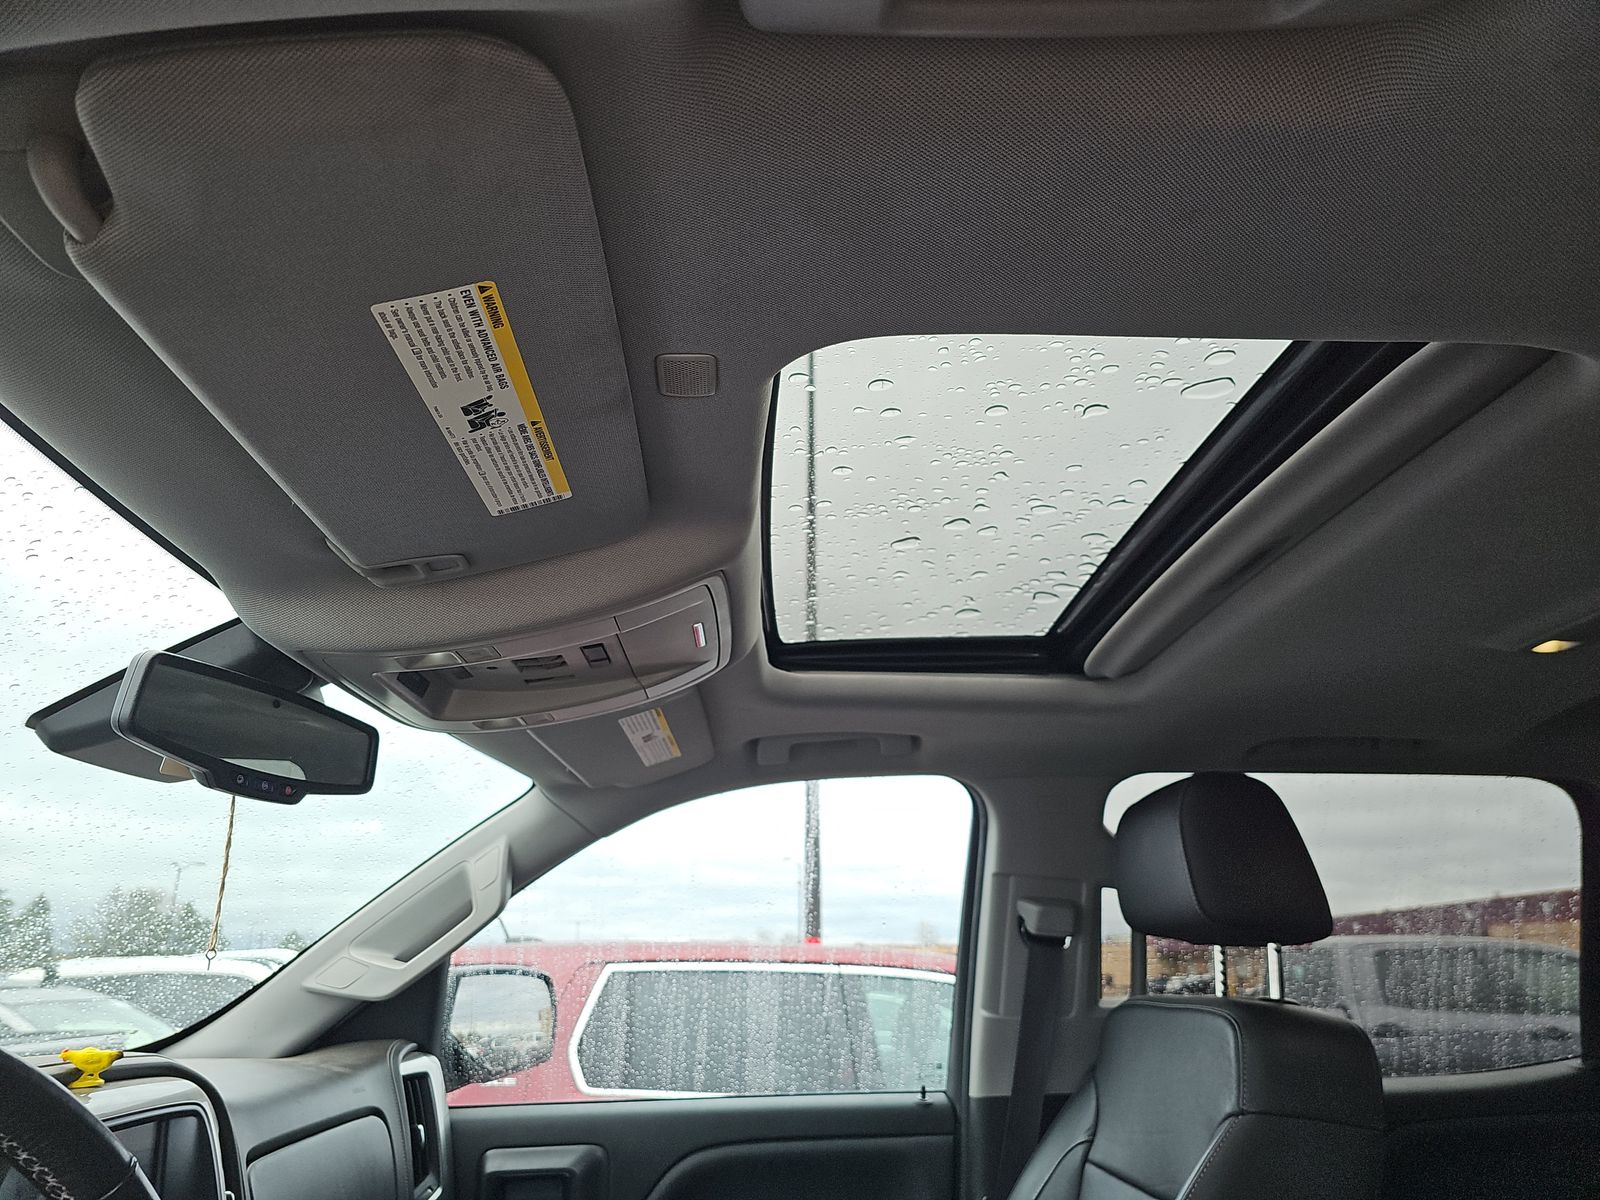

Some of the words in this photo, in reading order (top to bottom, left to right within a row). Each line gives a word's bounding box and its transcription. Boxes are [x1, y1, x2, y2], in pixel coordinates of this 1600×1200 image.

[433, 300, 444, 309] The
[459, 289, 476, 308] EVEN
[418, 303, 431, 316] Never
[446, 296, 461, 314] Children
[481, 293, 505, 329] WARNING
[377, 311, 390, 323] about
[390, 308, 401, 317] See
[403, 305, 418, 321] Always
[437, 308, 448, 319] back
[454, 314, 463, 322] can
[468, 309, 484, 327] WITH
[394, 317, 409, 333] owner's
[423, 315, 434, 323] put
[441, 318, 452, 328] seat
[416, 328, 426, 337] seat
[428, 326, 446, 347] rear-facing
[447, 331, 457, 339] the
[460, 327, 471, 338] killed
[403, 332, 417, 347] manual
[420, 336, 431, 347] belts
[451, 338, 462, 350] safest
[475, 327, 498, 362] ADVANCED
[425, 346, 435, 354] and
[440, 346, 451, 355] child
[455, 349, 467, 360] place
[465, 342, 480, 358] seriously
[429, 353, 440, 363] child
[444, 355, 454, 363] seat
[473, 357, 485, 370] injured
[418, 360, 429, 370] more
[490, 361, 503, 373] AIR
[423, 369, 440, 388] information
[495, 373, 509, 389] BAGS
[533, 425, 554, 461] AVERTISSEMENT
